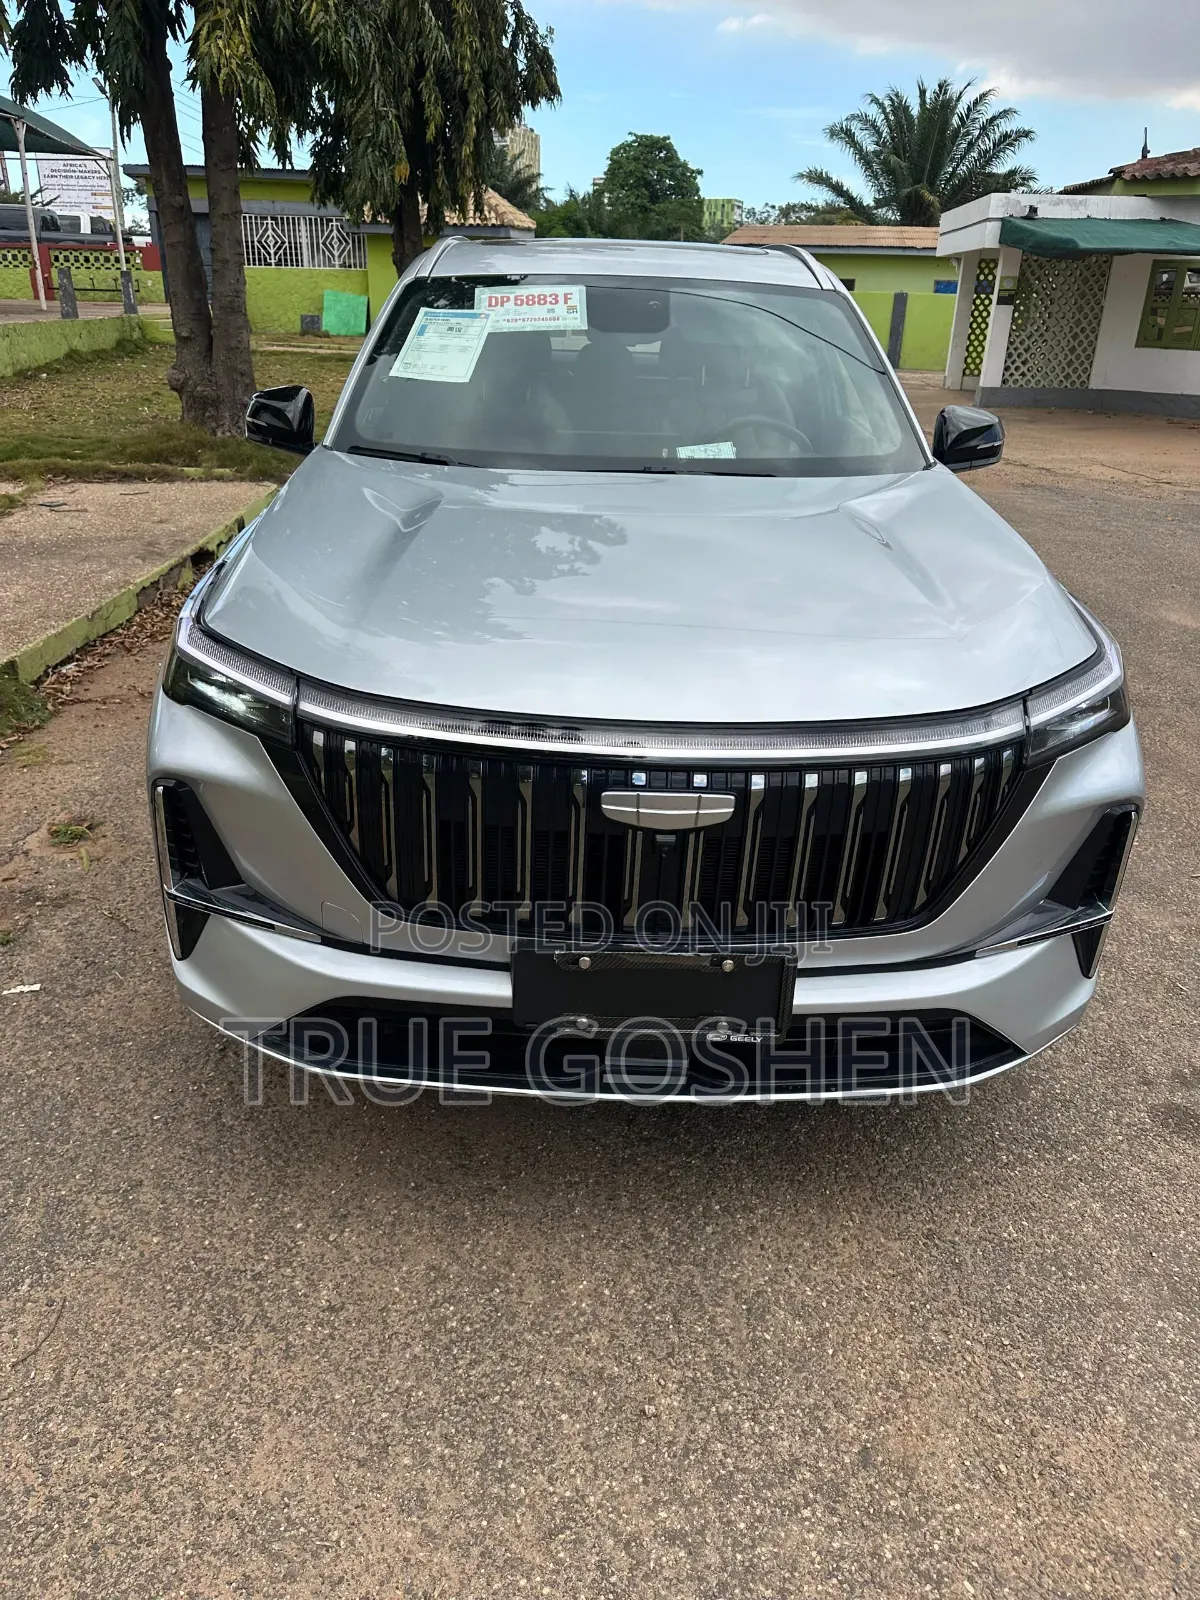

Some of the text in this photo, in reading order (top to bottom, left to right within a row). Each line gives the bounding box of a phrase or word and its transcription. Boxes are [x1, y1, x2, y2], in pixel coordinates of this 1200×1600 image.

[487, 292, 573, 308] DP 5883 F
